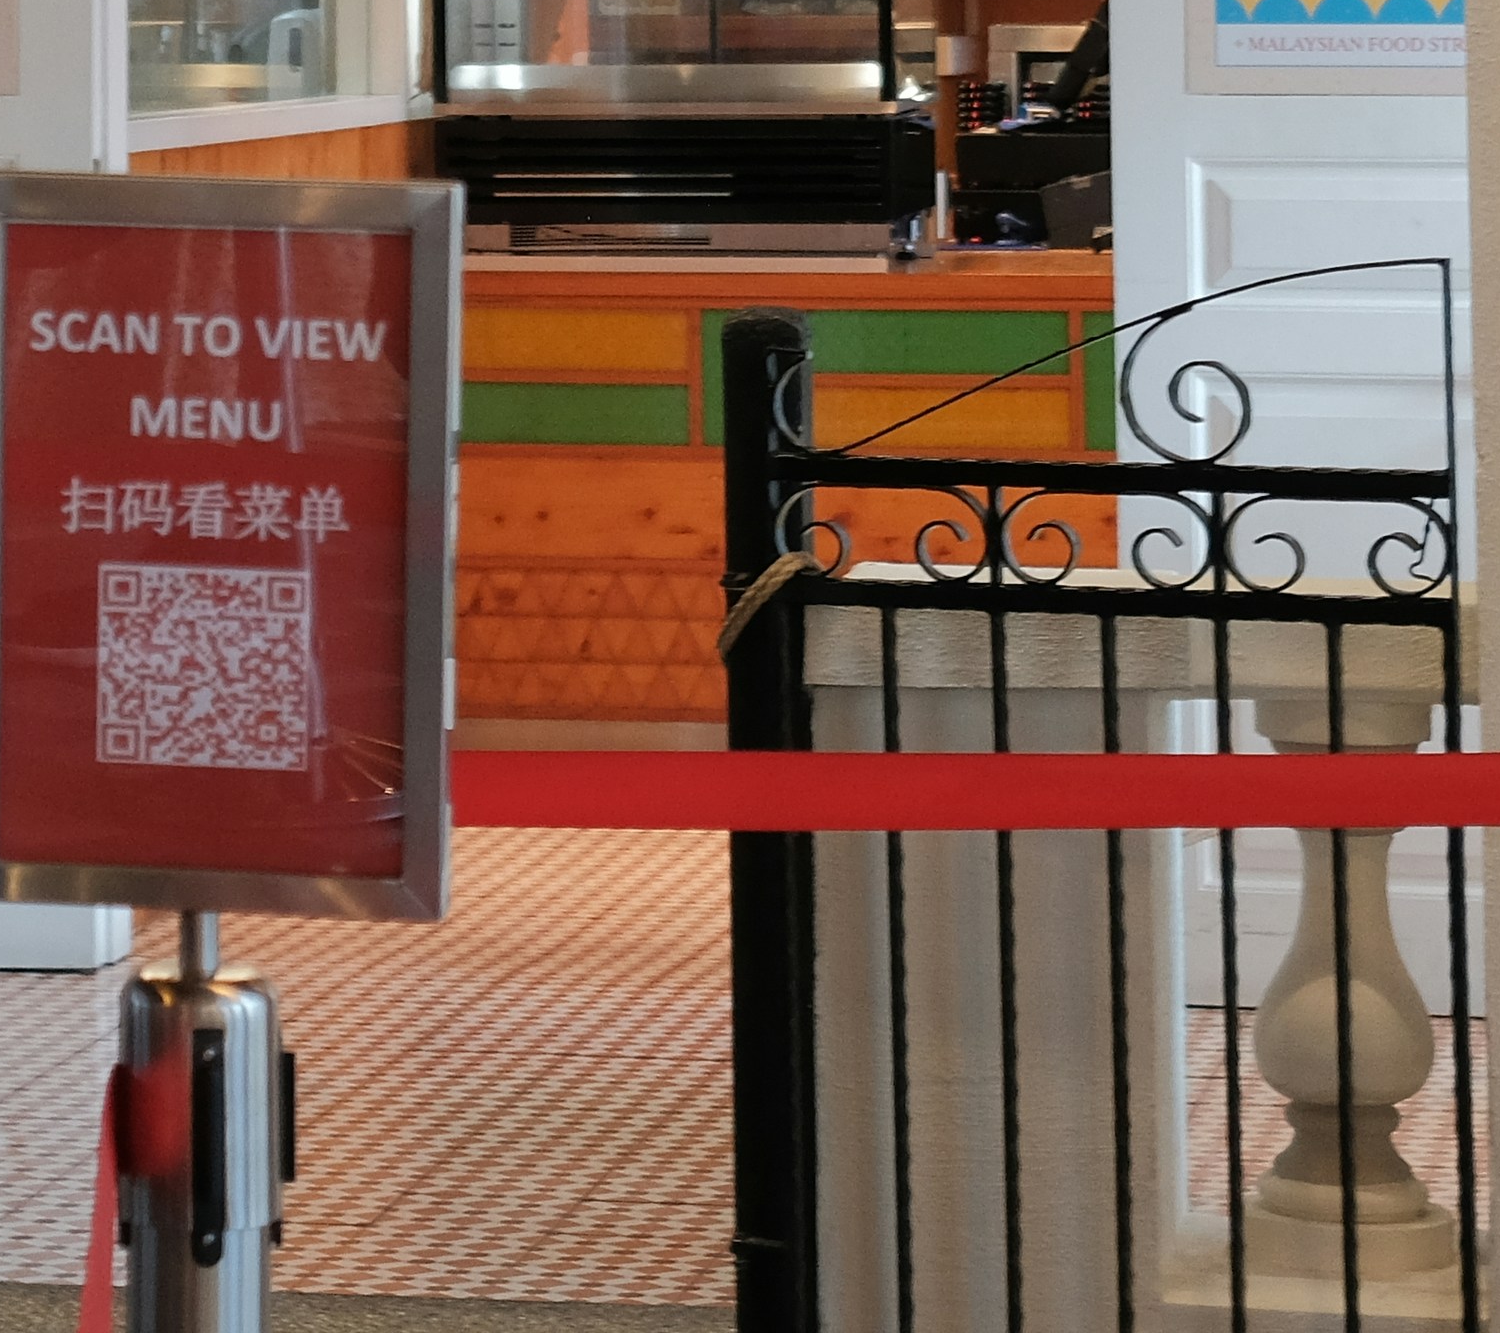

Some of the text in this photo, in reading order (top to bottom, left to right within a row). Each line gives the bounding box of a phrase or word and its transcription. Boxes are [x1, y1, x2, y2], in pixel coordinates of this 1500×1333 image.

[1248, 36, 1363, 53] MALAYSIAN
[1367, 36, 1425, 52] FOOD
[29, 309, 387, 363] SCAN TO VIEW
[129, 395, 284, 442] MENU
[60, 476, 350, 544] 扫码看菜单
